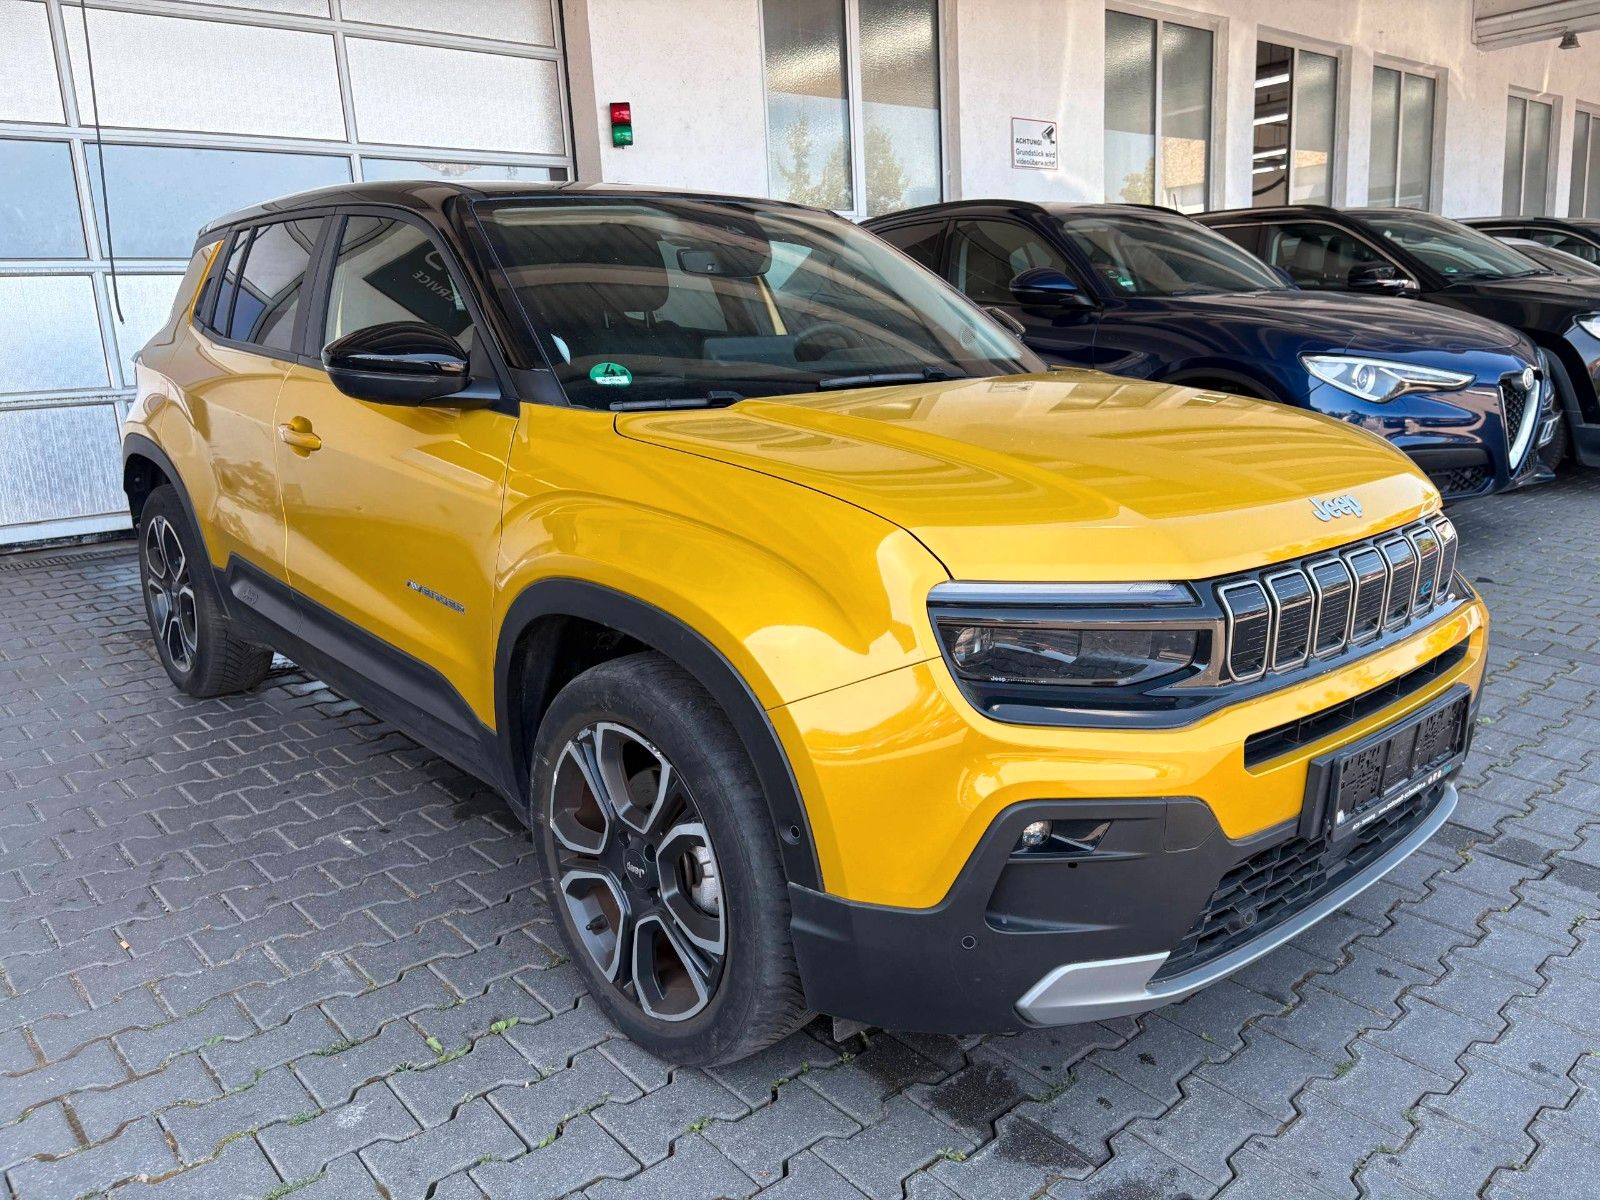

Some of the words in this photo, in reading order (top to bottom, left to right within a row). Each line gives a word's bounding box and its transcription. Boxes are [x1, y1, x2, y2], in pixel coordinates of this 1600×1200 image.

[1015, 137, 1043, 146] ACHTUNG!
[1015, 148, 1044, 158] Grundstück
[1045, 151, 1056, 159] wird
[604, 363, 616, 377] 4
[1308, 495, 1364, 522] Jeep
[990, 675, 1006, 683] Jeep
[626, 861, 645, 879] Jeep
